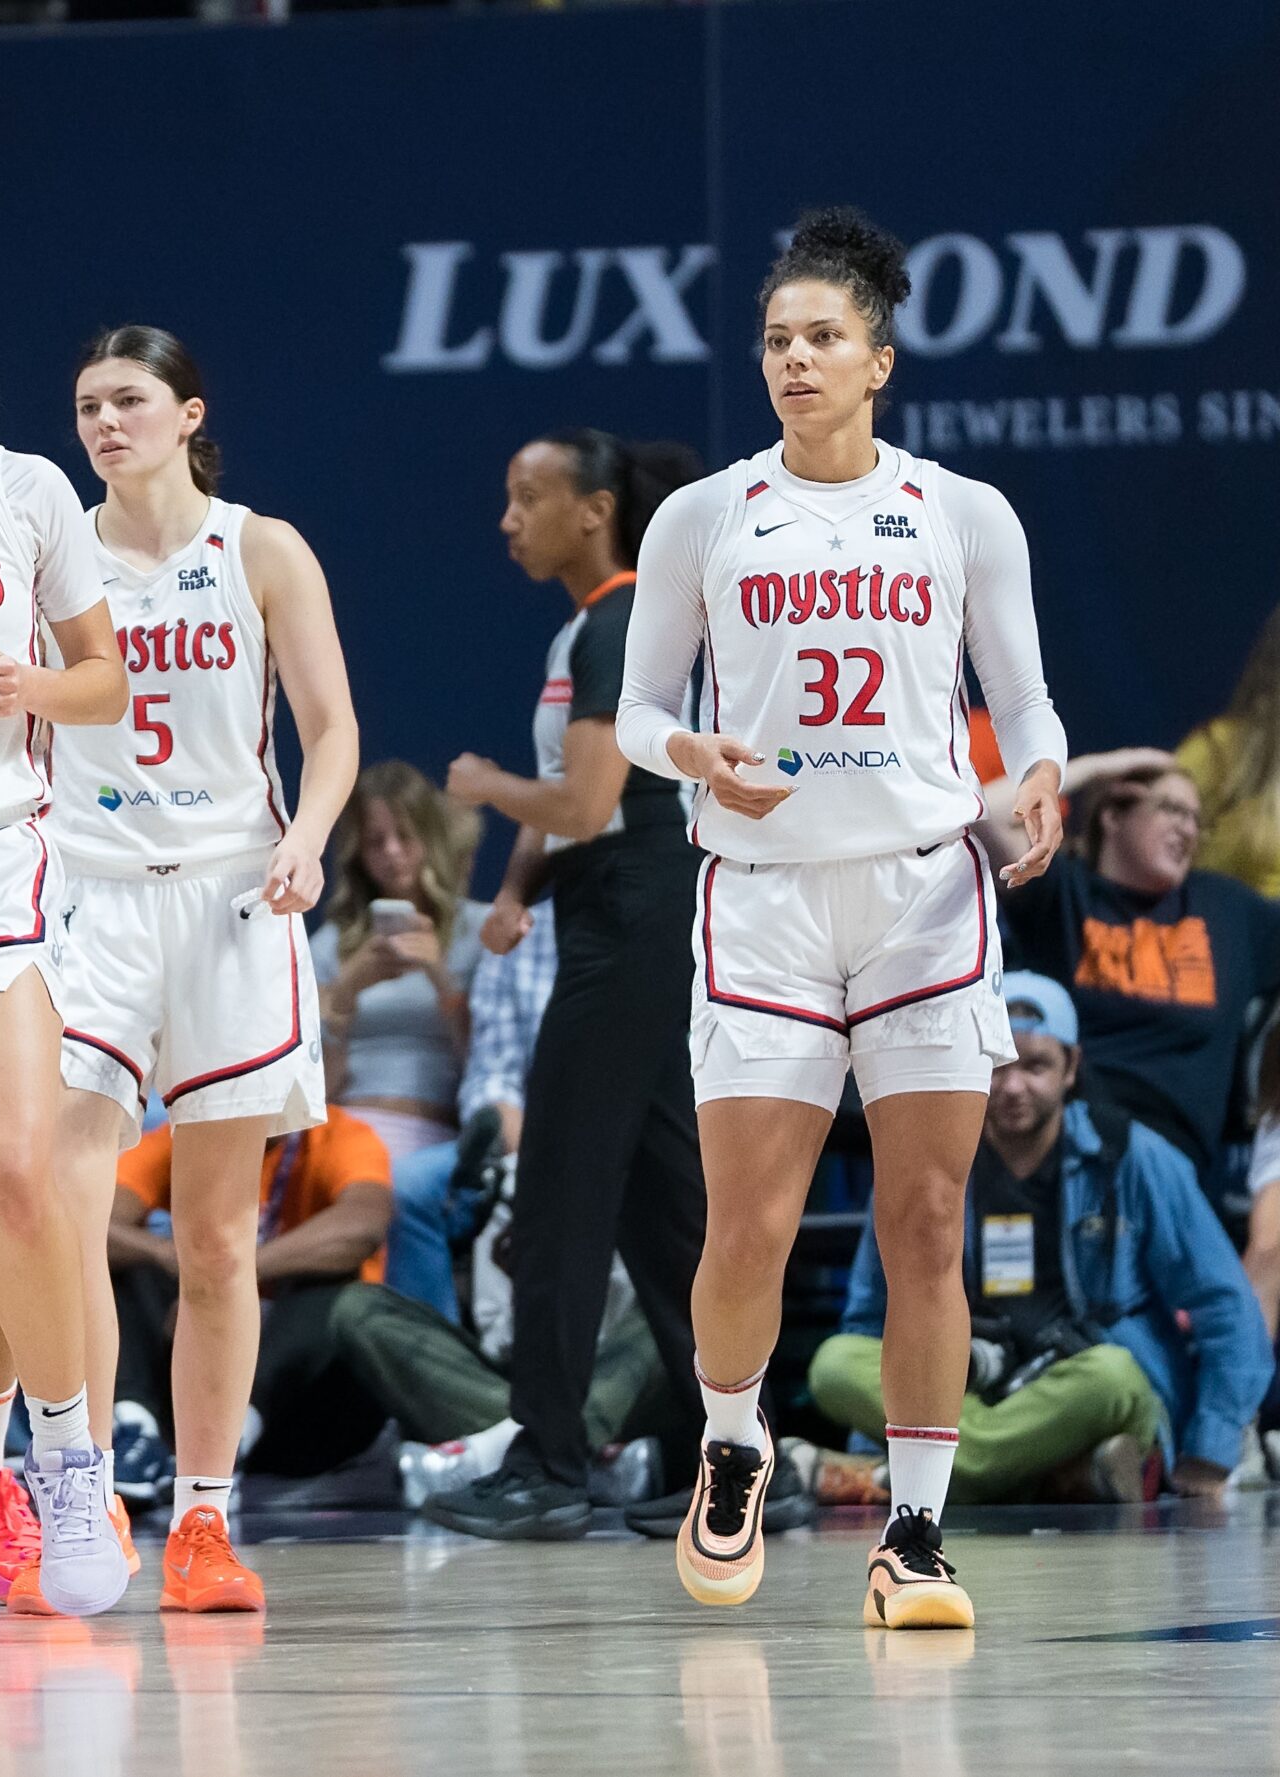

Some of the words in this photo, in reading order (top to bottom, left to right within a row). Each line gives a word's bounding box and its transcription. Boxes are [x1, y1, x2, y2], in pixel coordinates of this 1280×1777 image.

[380, 240, 719, 375] LUX
[754, 224, 1246, 358] OND
[872, 513, 909, 527] CAR
[874, 525, 918, 539] max
[177, 565, 209, 580] CAR
[178, 576, 218, 591] max
[116, 617, 236, 673] stics
[797, 647, 886, 726] 32
[132, 693, 174, 766] 5
[805, 751, 902, 769] VANDA
[123, 789, 214, 806] VANDA
